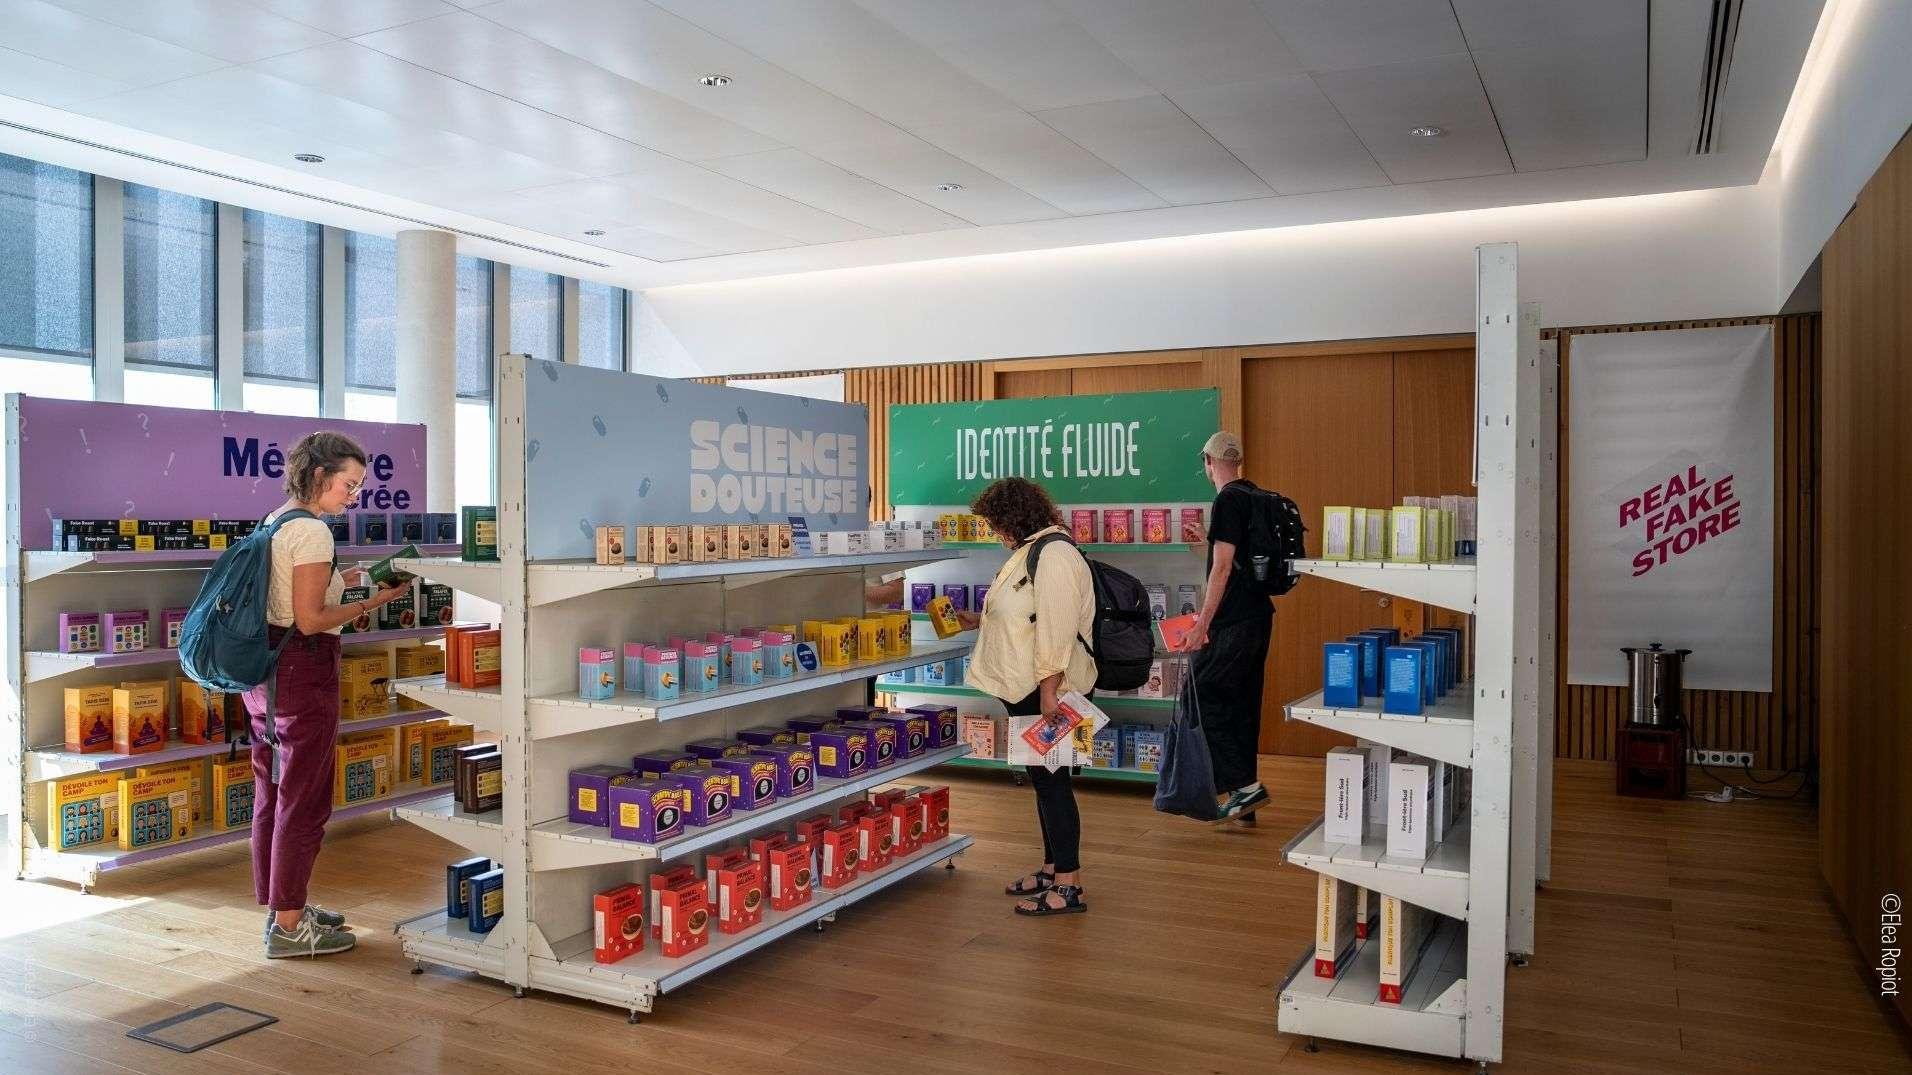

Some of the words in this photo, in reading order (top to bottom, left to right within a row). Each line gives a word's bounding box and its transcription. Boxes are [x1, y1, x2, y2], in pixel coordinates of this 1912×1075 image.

[690, 420, 857, 477] SCIENCE
[956, 419, 1053, 480] IDENTITÉ
[1062, 421, 1140, 478] FLUIDE
[690, 473, 857, 515] DOUTEUSE
[1619, 465, 1707, 528] REAL
[1646, 474, 1734, 543] FAKE
[1631, 500, 1741, 577] STORE
